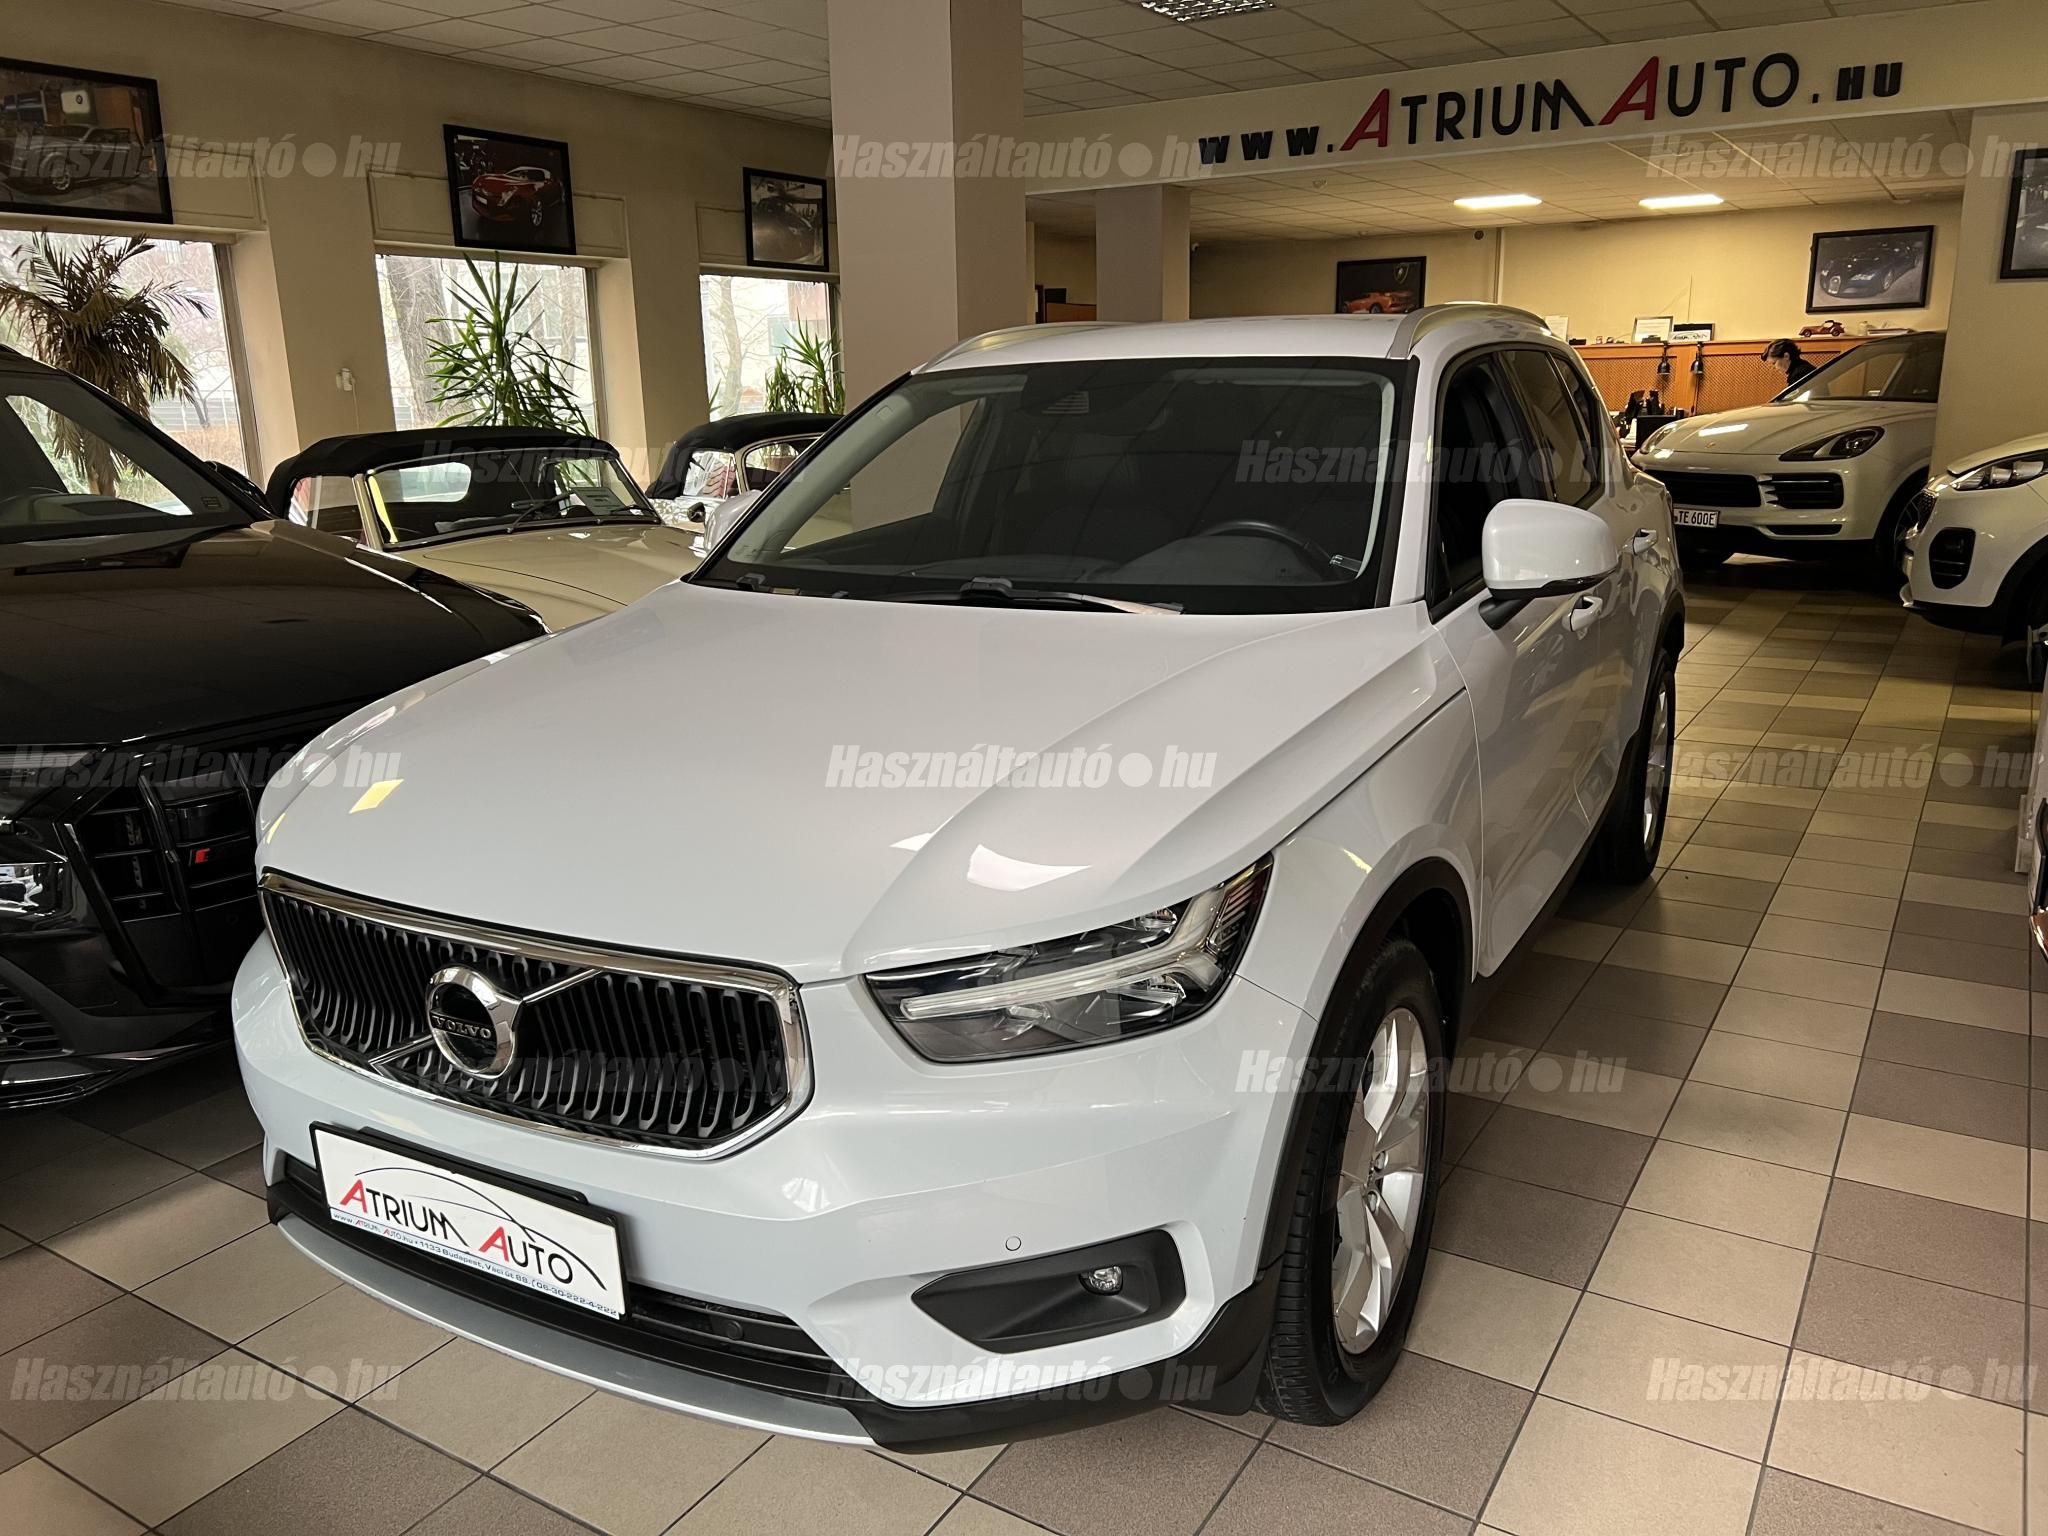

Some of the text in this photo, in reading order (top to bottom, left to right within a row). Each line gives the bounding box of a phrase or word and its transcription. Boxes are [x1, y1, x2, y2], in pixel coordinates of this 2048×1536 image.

[432, 1016, 492, 1039] VOLVO
[419, 1240, 441, 1254] 1133
[442, 1249, 484, 1269] Budapest,
[478, 1226, 573, 1285] AUTO
